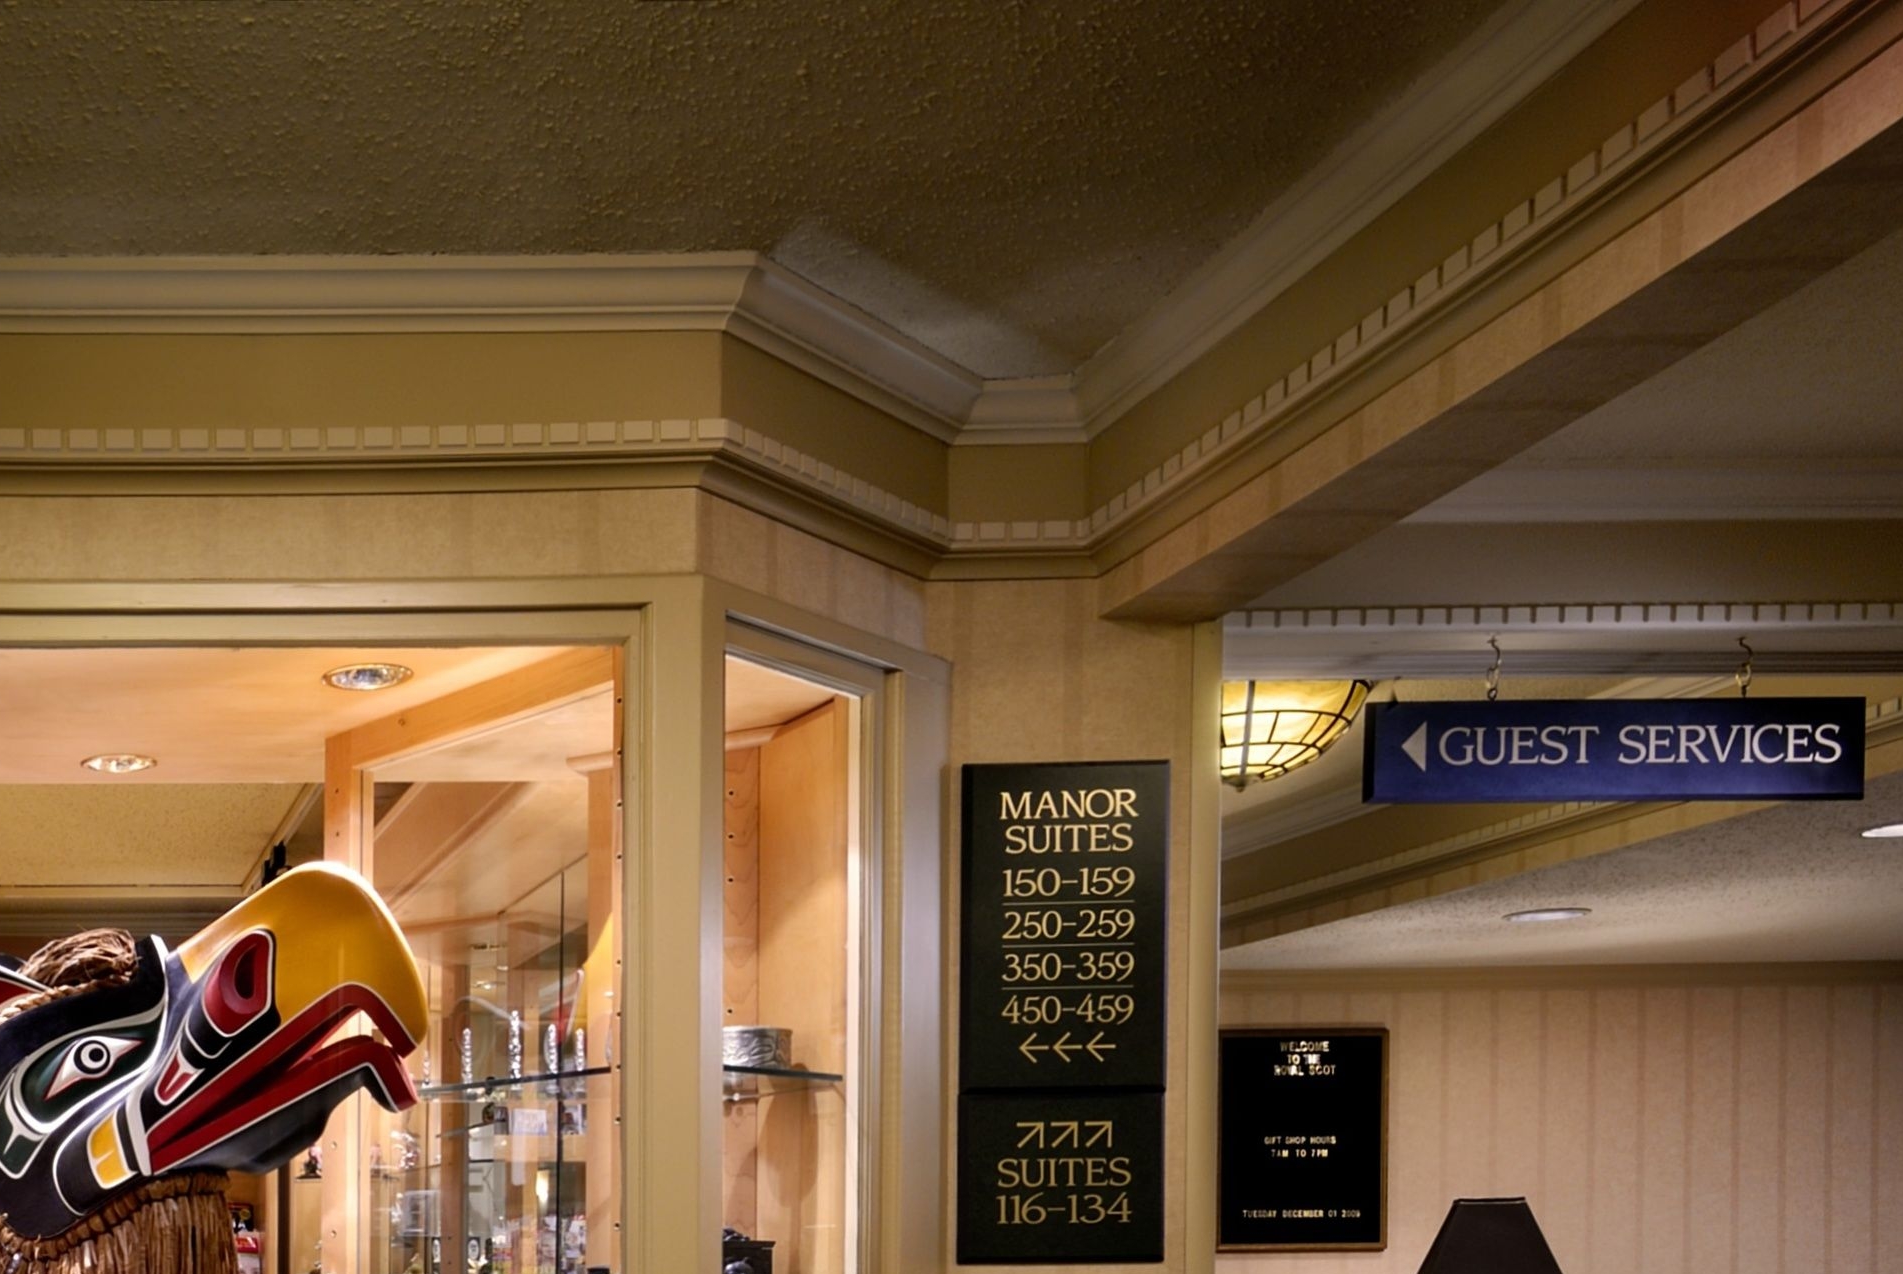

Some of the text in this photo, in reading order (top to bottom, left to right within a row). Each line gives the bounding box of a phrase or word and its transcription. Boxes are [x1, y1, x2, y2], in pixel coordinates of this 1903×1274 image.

[1439, 724, 1842, 766] GUEST SERVICES
[1000, 788, 1139, 820] MANOR
[1005, 823, 1133, 854] SUITES
[1002, 867, 1135, 897] 150-159
[1002, 909, 1135, 939] 250-259
[1002, 952, 1134, 982] 350-359
[1001, 994, 1134, 1025] 450-459
[1280, 1041, 1330, 1053] WELCOME
[1287, 1053, 1301, 1065] TO
[1274, 1064, 1336, 1076] ROYAL SCOT
[1264, 1136, 1337, 1145] GIFT SHOP HOURS
[1295, 1148, 1307, 1158] TO
[998, 1158, 1131, 1188] SUITES
[997, 1193, 1131, 1224] 116-134
[1242, 1209, 1277, 1219] TUESDAY
[1282, 1209, 1324, 1219] DECEMBER
